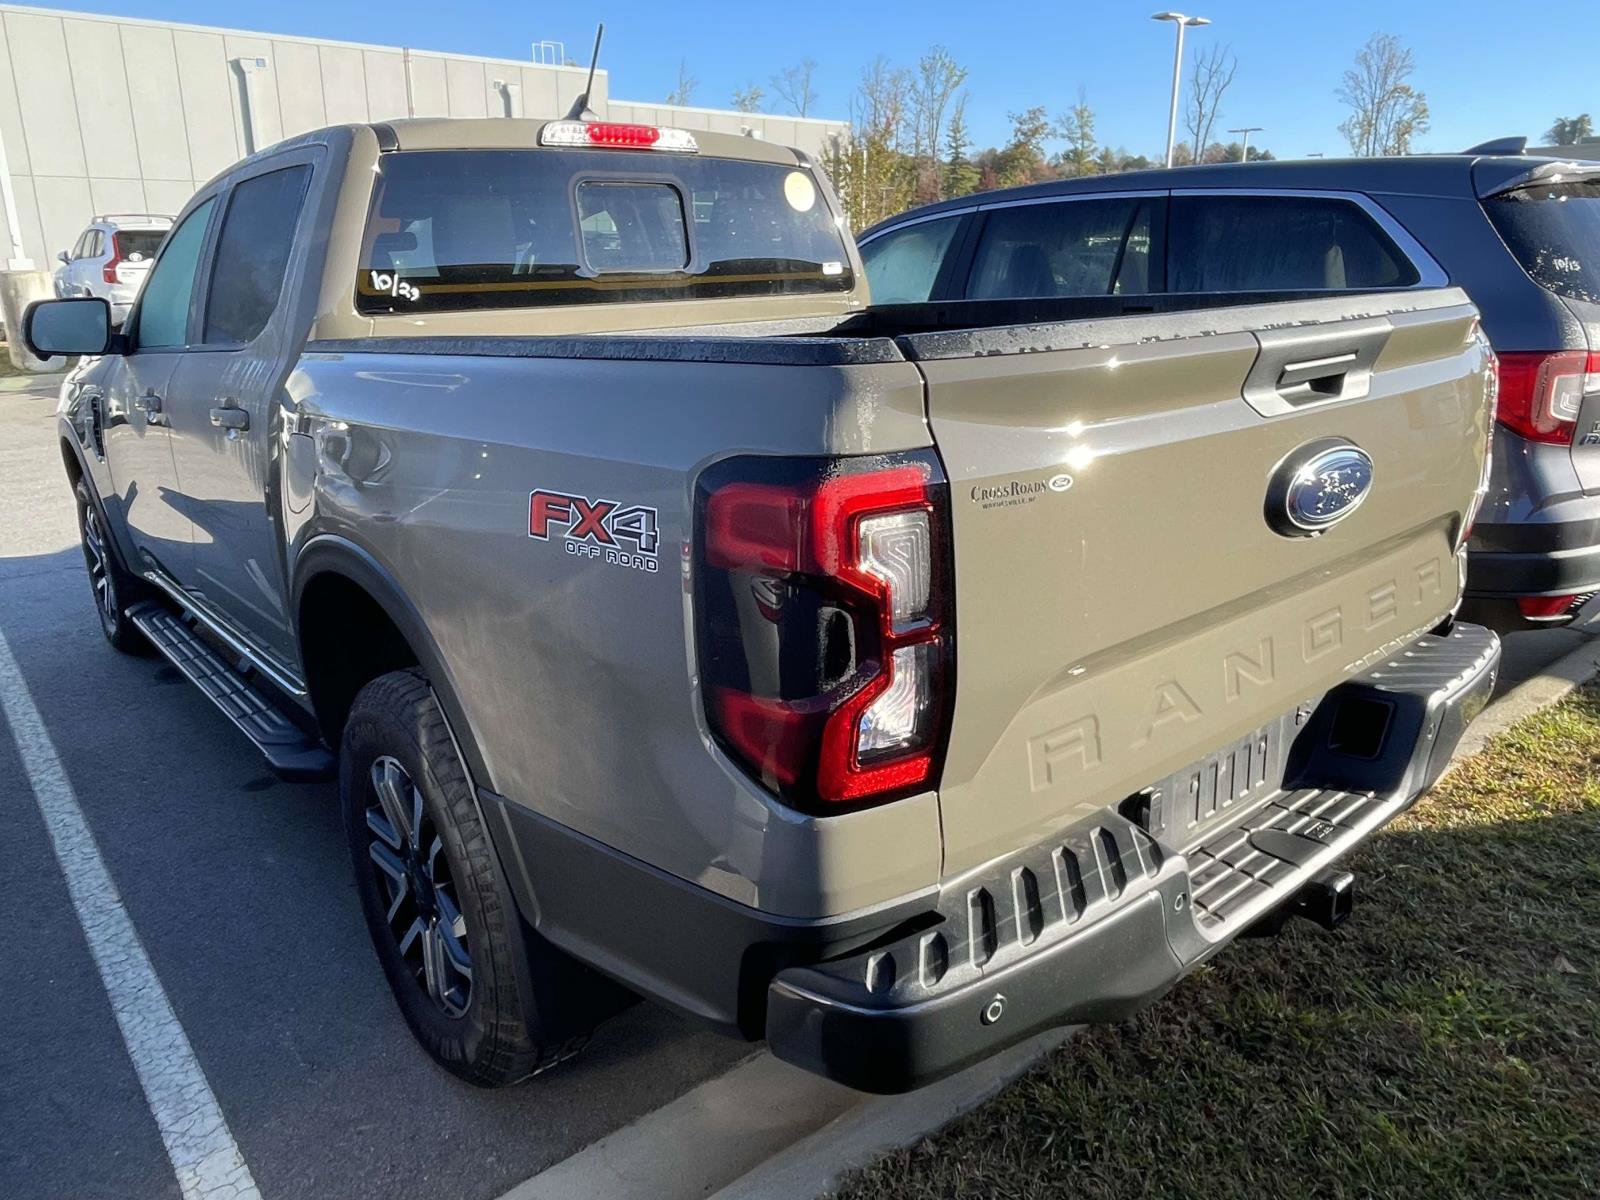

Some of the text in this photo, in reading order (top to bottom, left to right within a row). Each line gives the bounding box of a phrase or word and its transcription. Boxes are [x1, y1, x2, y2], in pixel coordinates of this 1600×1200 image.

[370, 270, 420, 302] 10/23
[528, 488, 660, 556] FX4
[565, 540, 659, 573] OFF ROAD
[1026, 556, 1442, 793] RANGER
